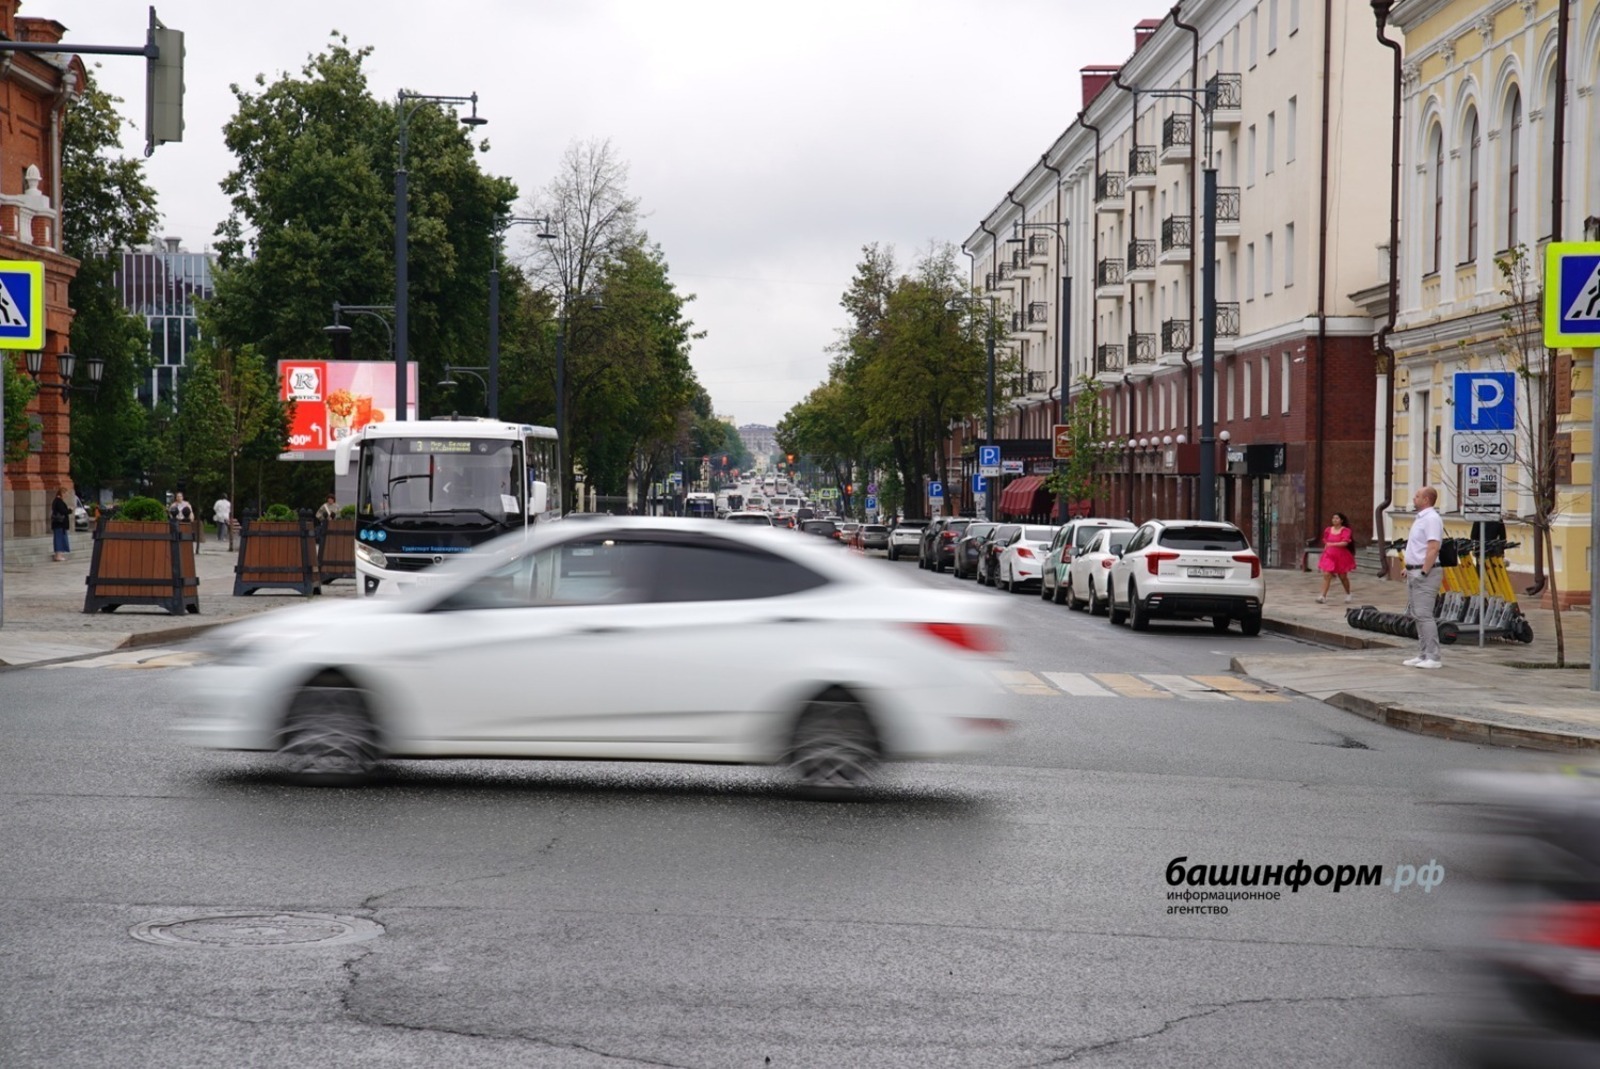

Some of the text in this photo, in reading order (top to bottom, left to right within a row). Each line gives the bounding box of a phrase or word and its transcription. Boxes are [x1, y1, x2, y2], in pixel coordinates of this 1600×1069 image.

[1471, 378, 1504, 425] P
[416, 441, 423, 451] 3
[1461, 443, 1508, 455] 10 15 20
[984, 448, 995, 464] P
[933, 484, 942, 495] P
[868, 500, 875, 508] P
